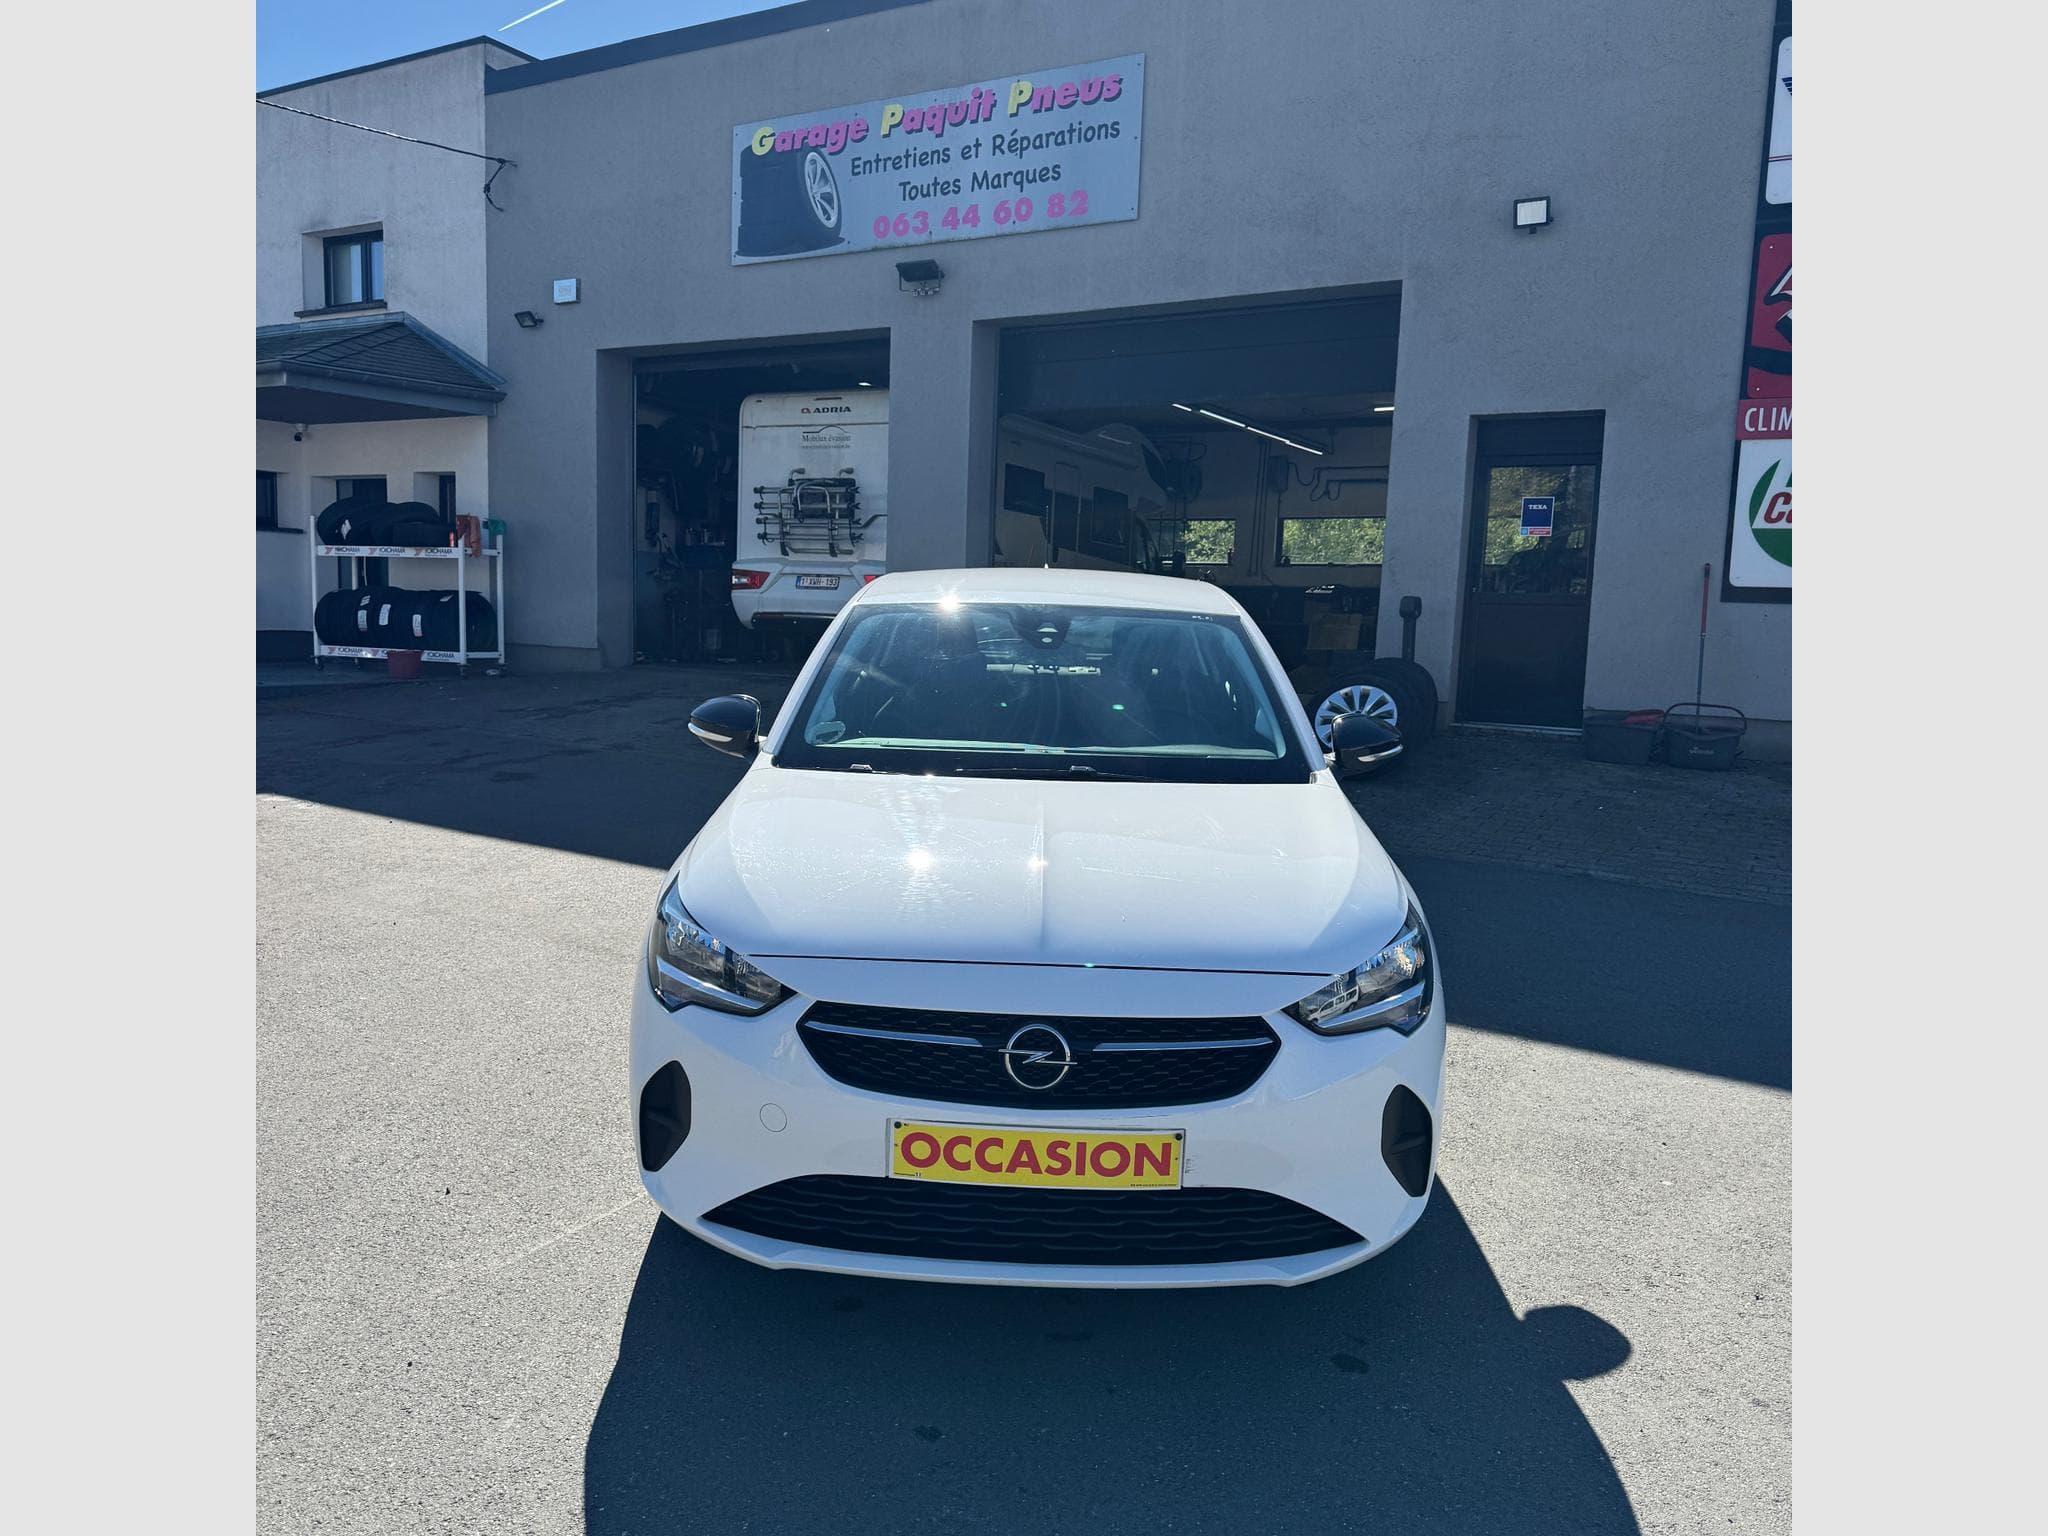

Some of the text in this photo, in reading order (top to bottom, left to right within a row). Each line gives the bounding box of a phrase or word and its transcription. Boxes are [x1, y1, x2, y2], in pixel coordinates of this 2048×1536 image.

[751, 72, 1123, 158] Garage Paquit Pneus
[851, 118, 1121, 177] Entretiens et Réparations
[899, 163, 1061, 201] Toutes Marques
[873, 190, 1089, 240] 063 44 60 82
[813, 406, 851, 414] ADRIA
[901, 1132, 1172, 1177] OCCASION
